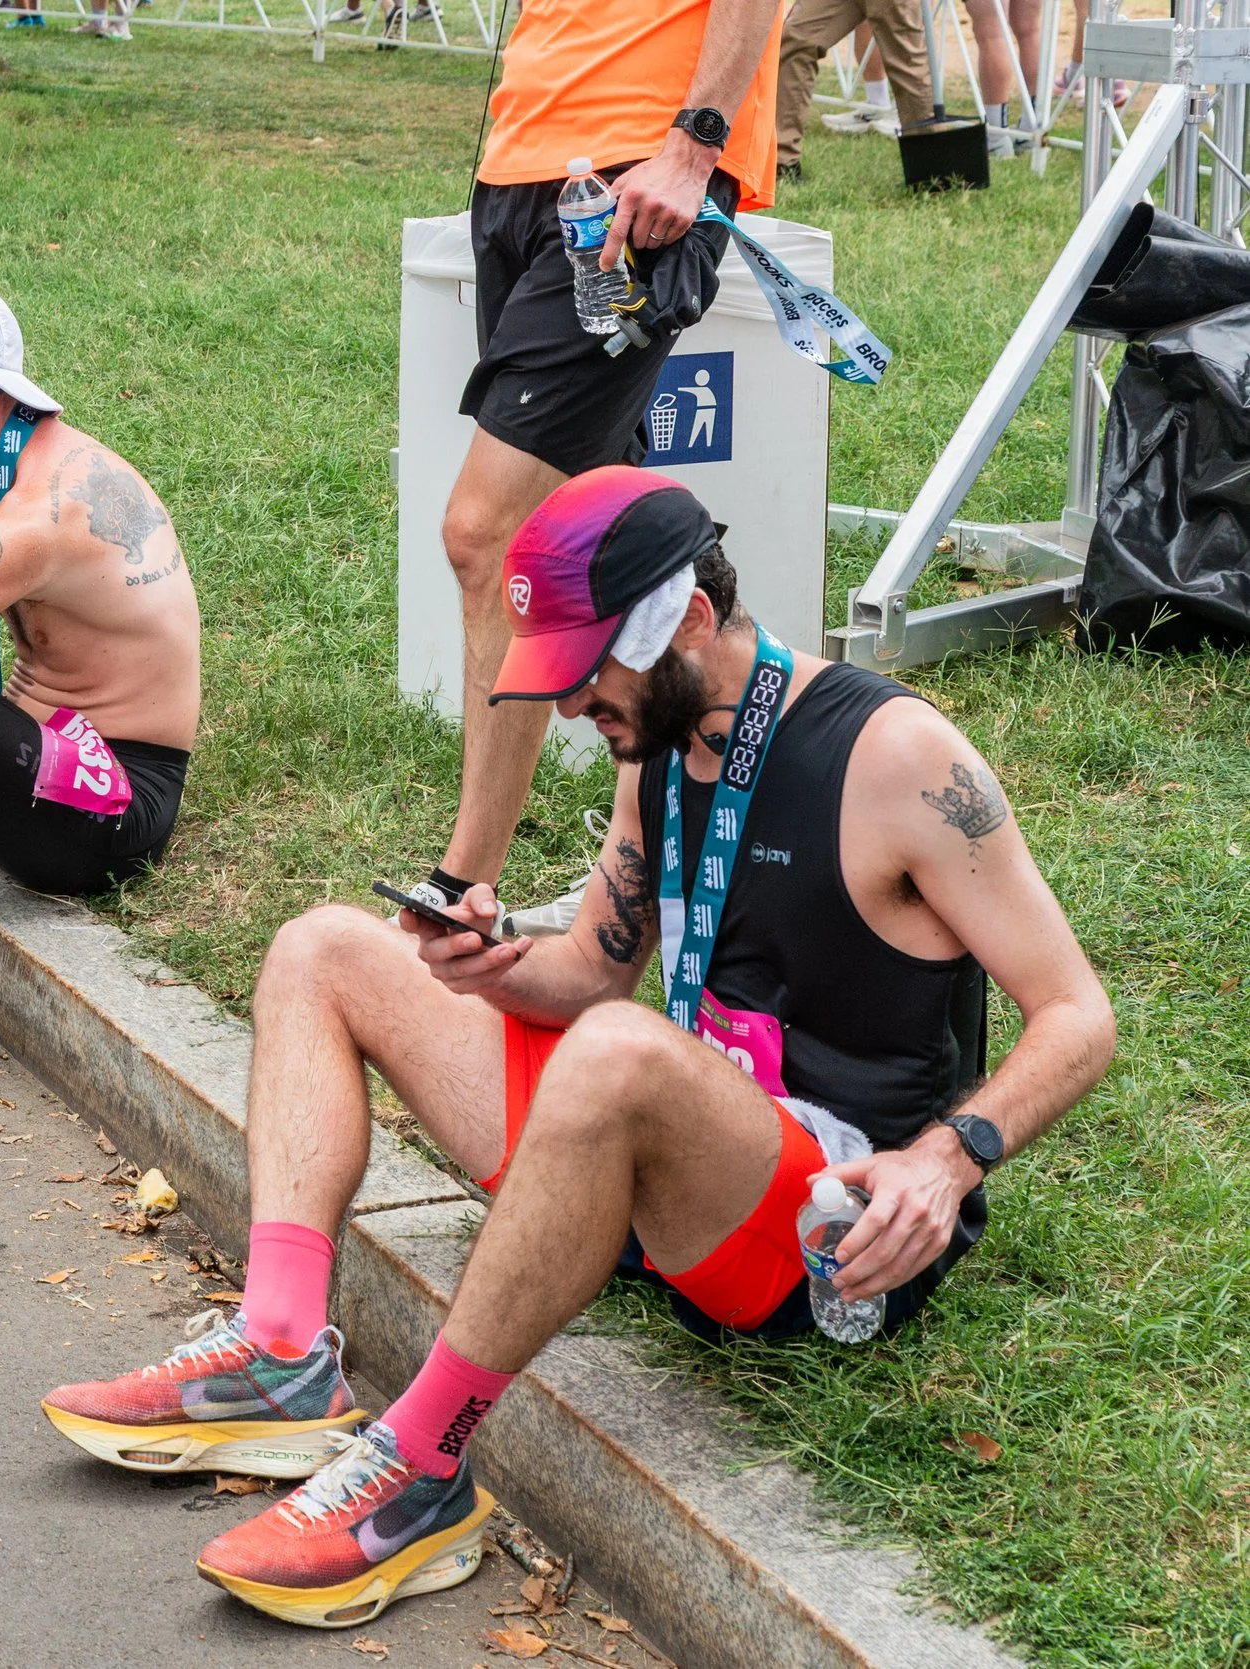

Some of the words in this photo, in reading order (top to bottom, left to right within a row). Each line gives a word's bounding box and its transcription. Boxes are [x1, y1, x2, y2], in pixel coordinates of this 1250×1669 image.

[743, 241, 795, 289] BROOKS
[800, 292, 849, 329] pacers
[855, 343, 888, 376] BRO
[765, 847, 792, 867] janji
[437, 1395, 493, 1459] BROOKS
